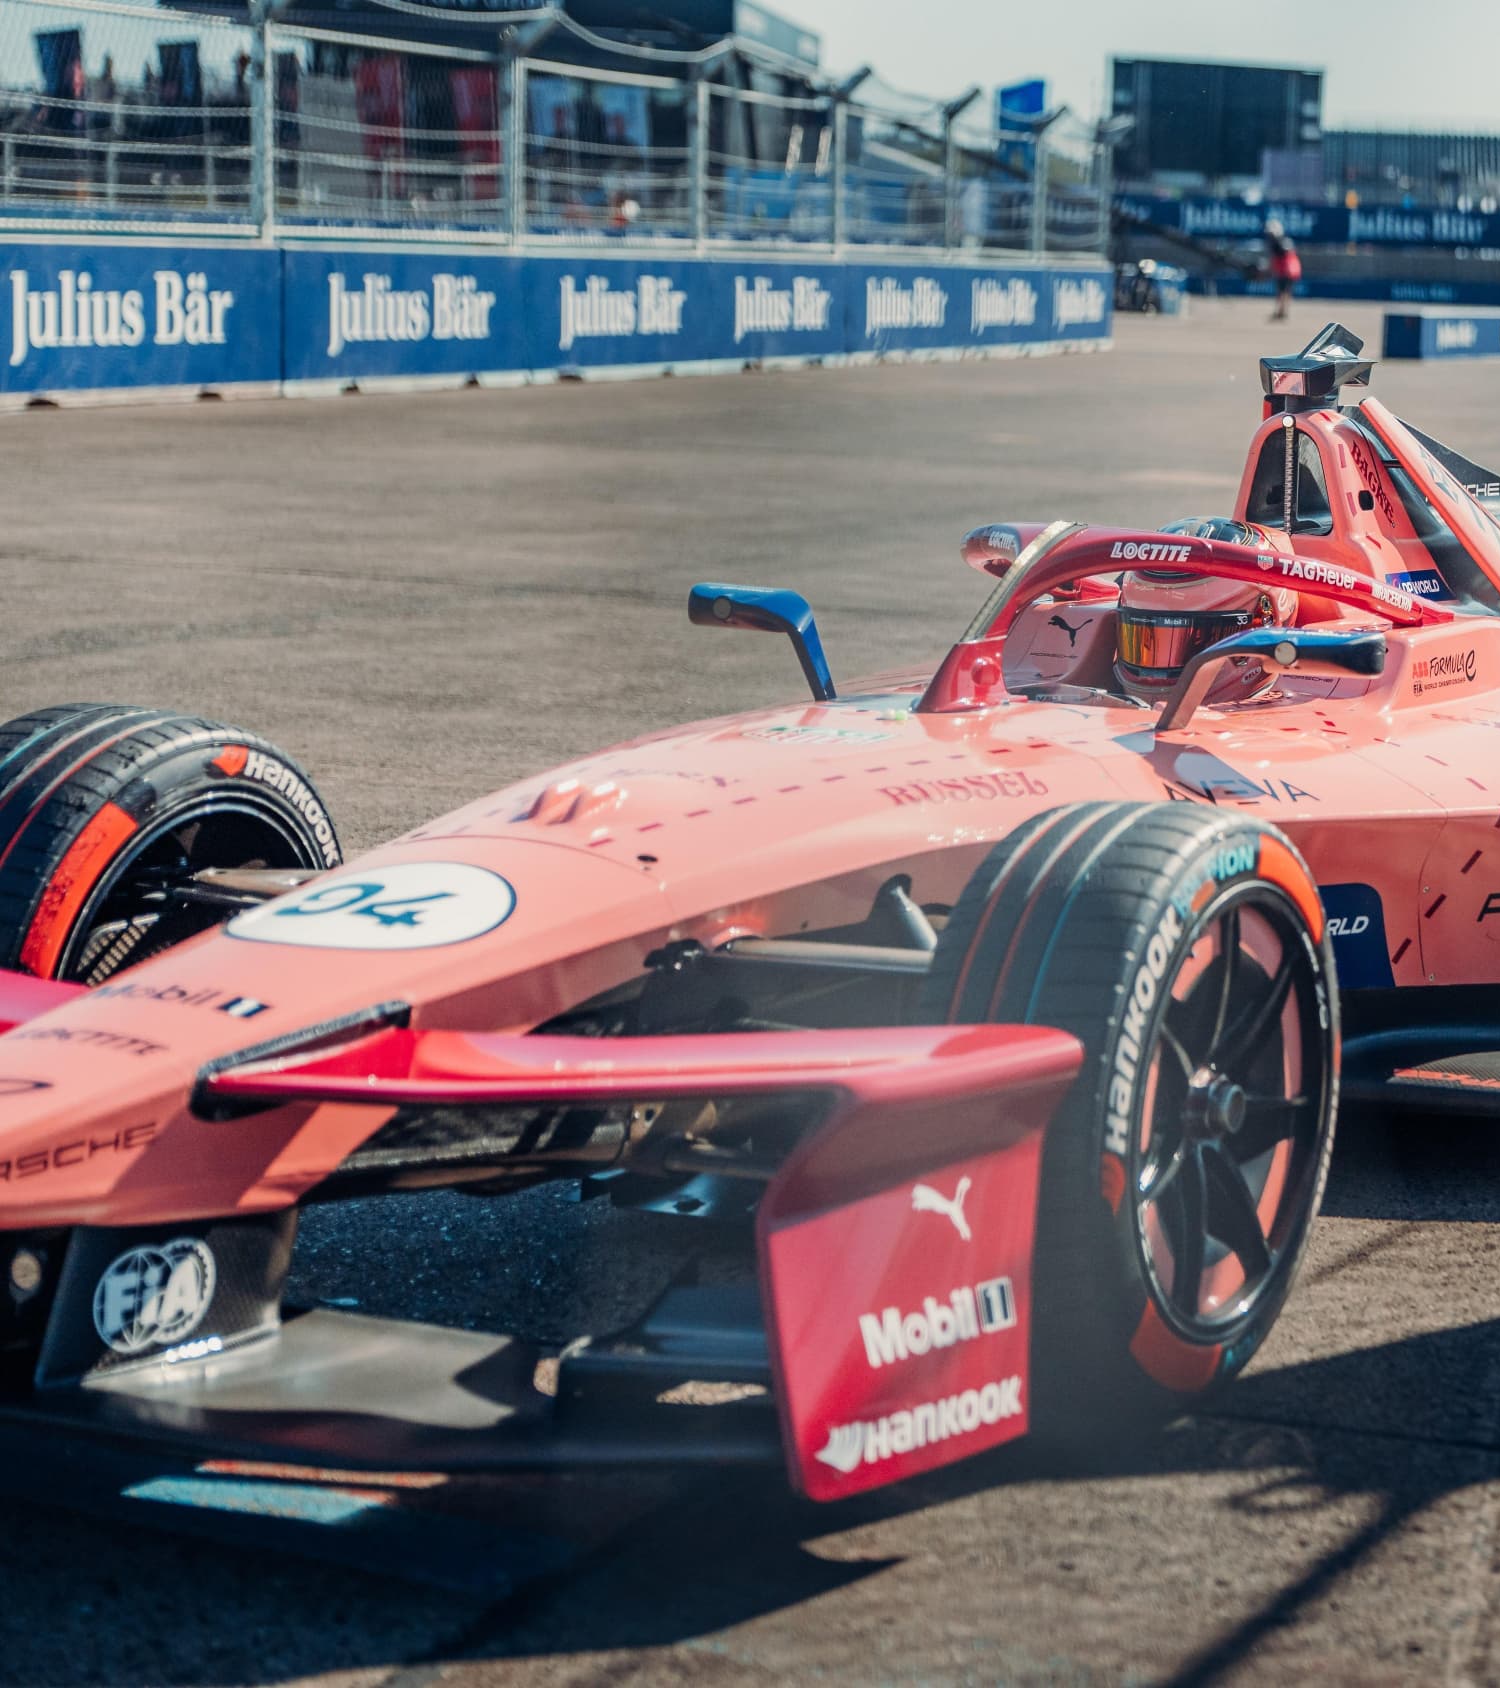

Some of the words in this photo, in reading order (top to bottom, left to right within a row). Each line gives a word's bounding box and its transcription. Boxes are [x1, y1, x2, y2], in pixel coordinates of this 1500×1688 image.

[9, 269, 145, 367] Julius
[154, 270, 235, 345] Bär
[326, 271, 430, 357] Julius
[432, 273, 497, 341] Bär
[559, 275, 636, 351] Julius
[636, 275, 688, 336] Bär
[733, 276, 792, 344] Julius
[792, 276, 834, 332] Bär
[1110, 542, 1192, 562] LOCTITE
[1413, 661, 1428, 679] ABB
[274, 883, 458, 928] 94
[1326, 914, 1369, 937] RLD
[0, 1121, 157, 1183] SCHE
[859, 1286, 980, 1369] Mobil
